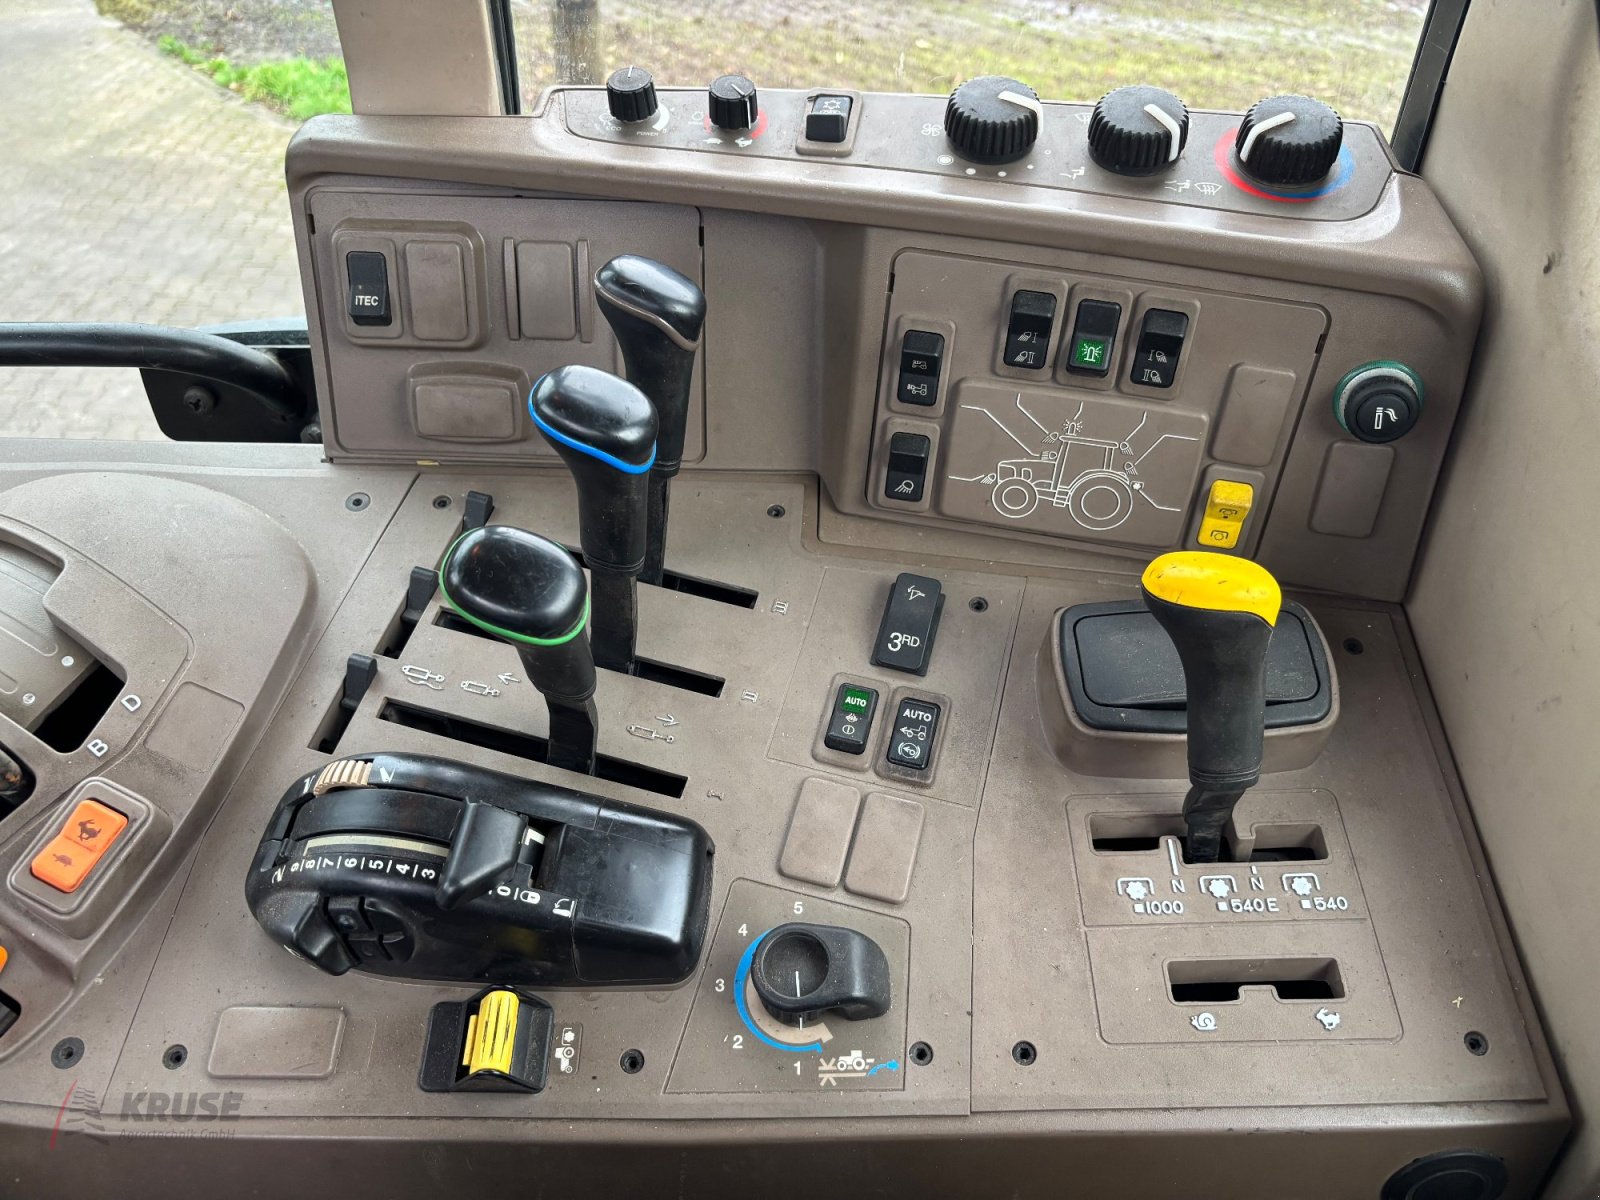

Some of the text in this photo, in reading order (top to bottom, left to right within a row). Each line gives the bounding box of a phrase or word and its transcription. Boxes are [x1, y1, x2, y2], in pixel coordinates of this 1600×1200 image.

[887, 632, 920, 652] 3RD
[121, 694, 142, 712] D
[844, 696, 867, 708] AUTO
[902, 708, 932, 722] AUTO
[87, 738, 109, 758] B
[1171, 879, 1186, 893] N
[1250, 876, 1265, 891] N
[793, 902, 803, 915] 5
[1314, 896, 1349, 911] 540
[738, 923, 748, 937] 4
[715, 978, 725, 993] 3
[732, 1034, 744, 1050] 2
[793, 1060, 802, 1076] 1
